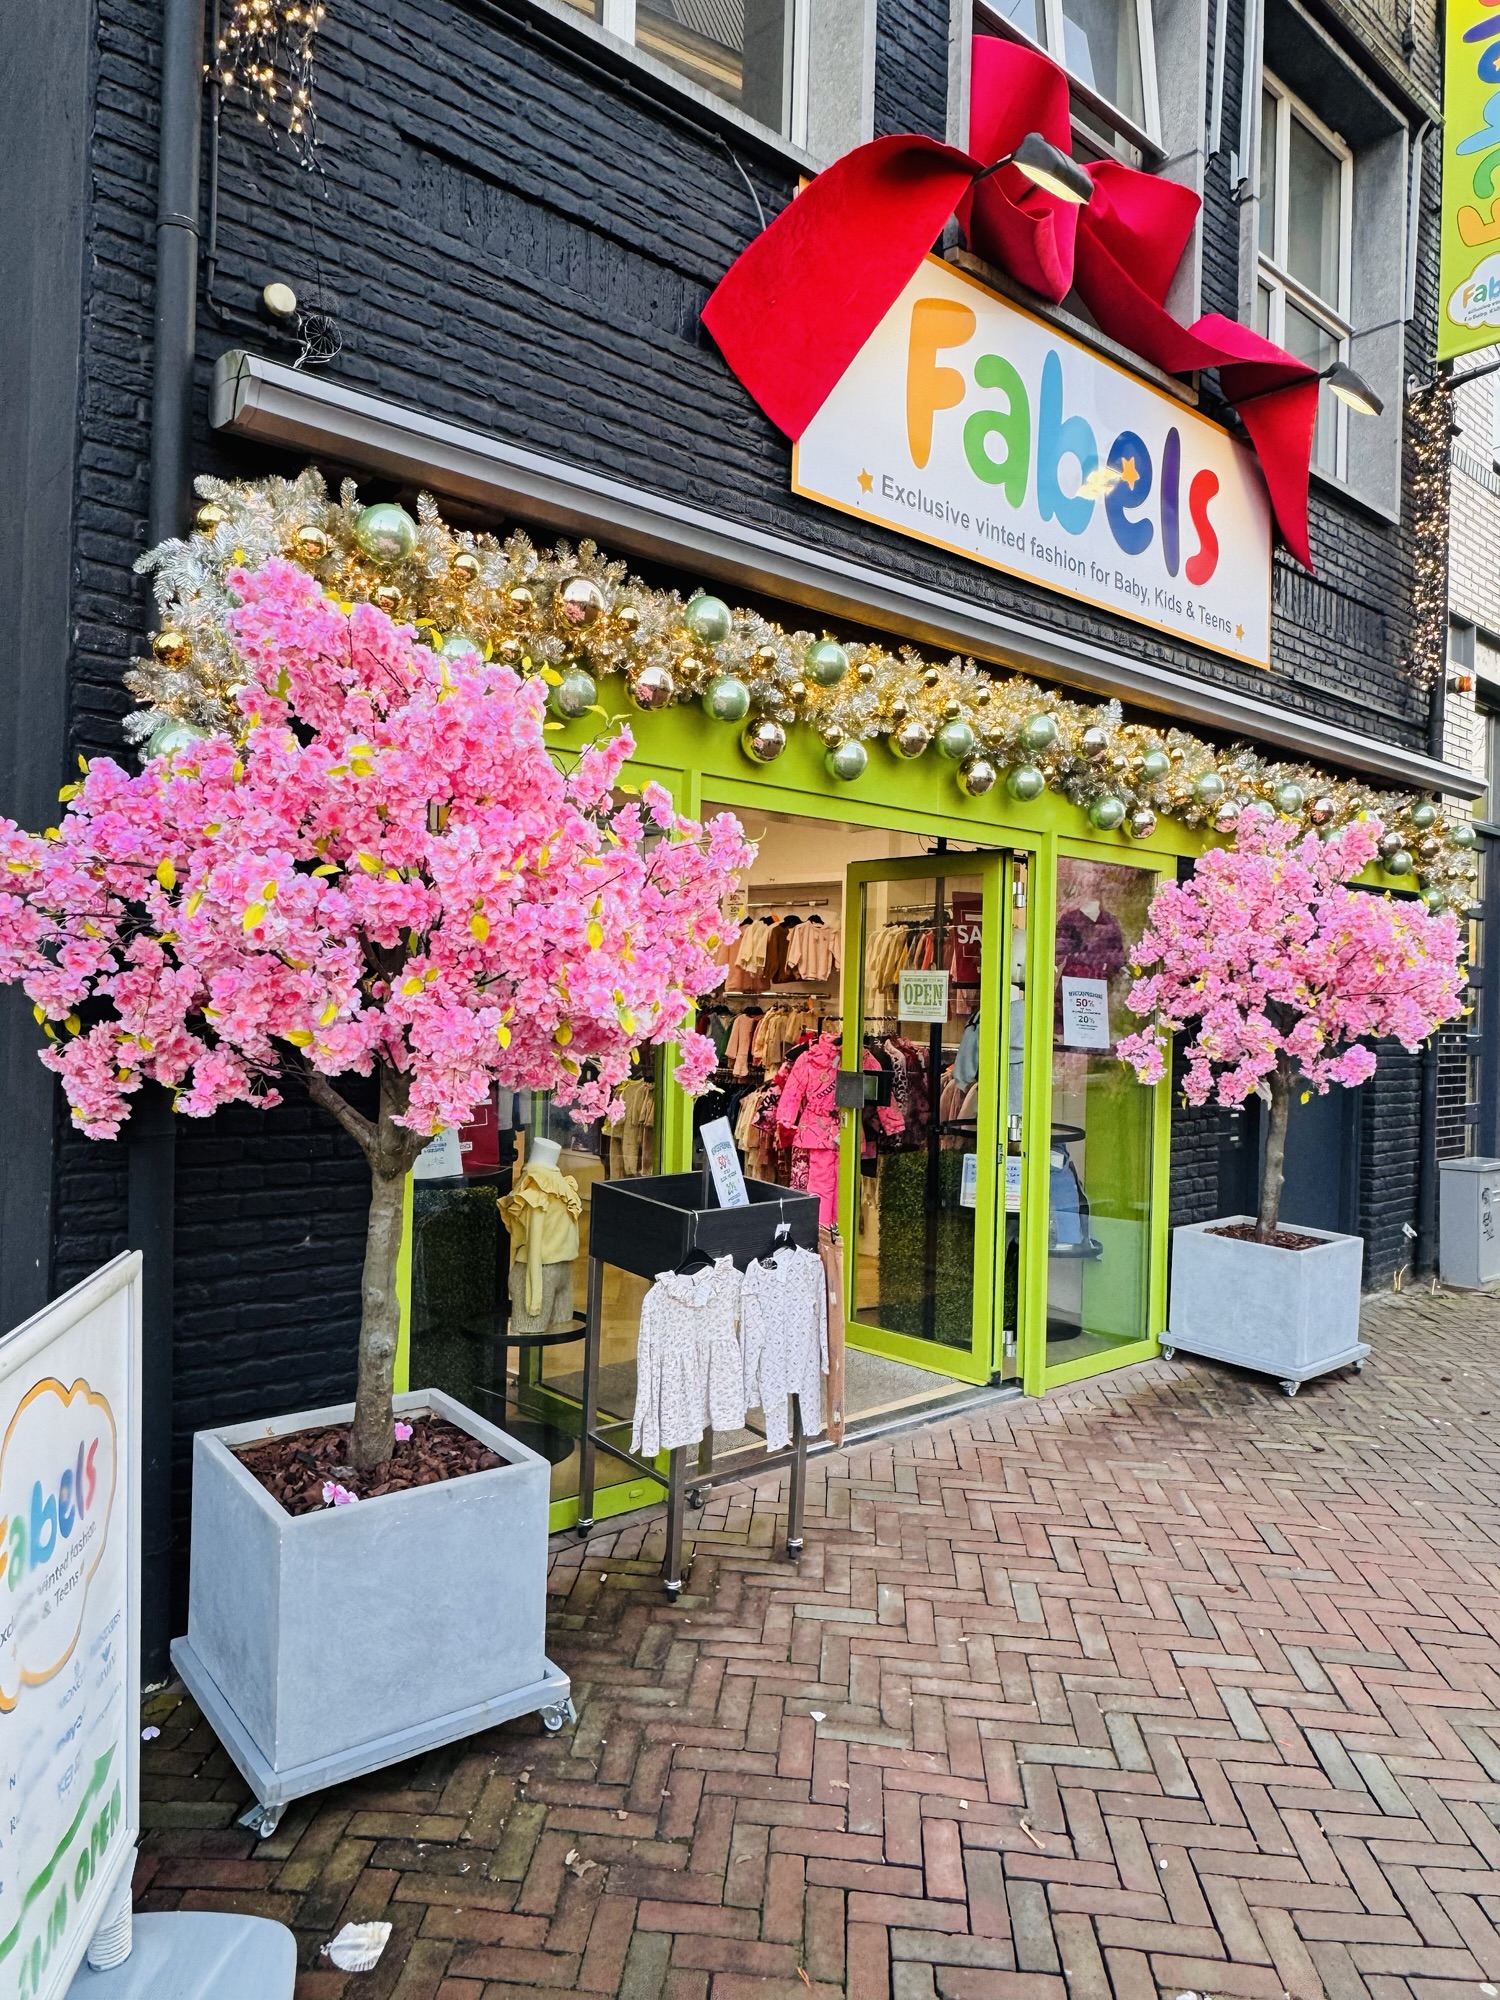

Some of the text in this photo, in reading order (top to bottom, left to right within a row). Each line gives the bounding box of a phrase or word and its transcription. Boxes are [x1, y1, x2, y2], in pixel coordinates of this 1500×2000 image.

[906, 298, 1219, 587] Fabels
[881, 474, 1232, 634] Exclusive vinted fashion for Baby, Kids & Teens
[903, 983, 944, 1007] OPEN
[1075, 998, 1095, 1008] 50%
[1078, 1015, 1095, 1024] 20%
[54, 1570, 80, 1607] Teens
[75, 1777, 122, 1903] OPEN
